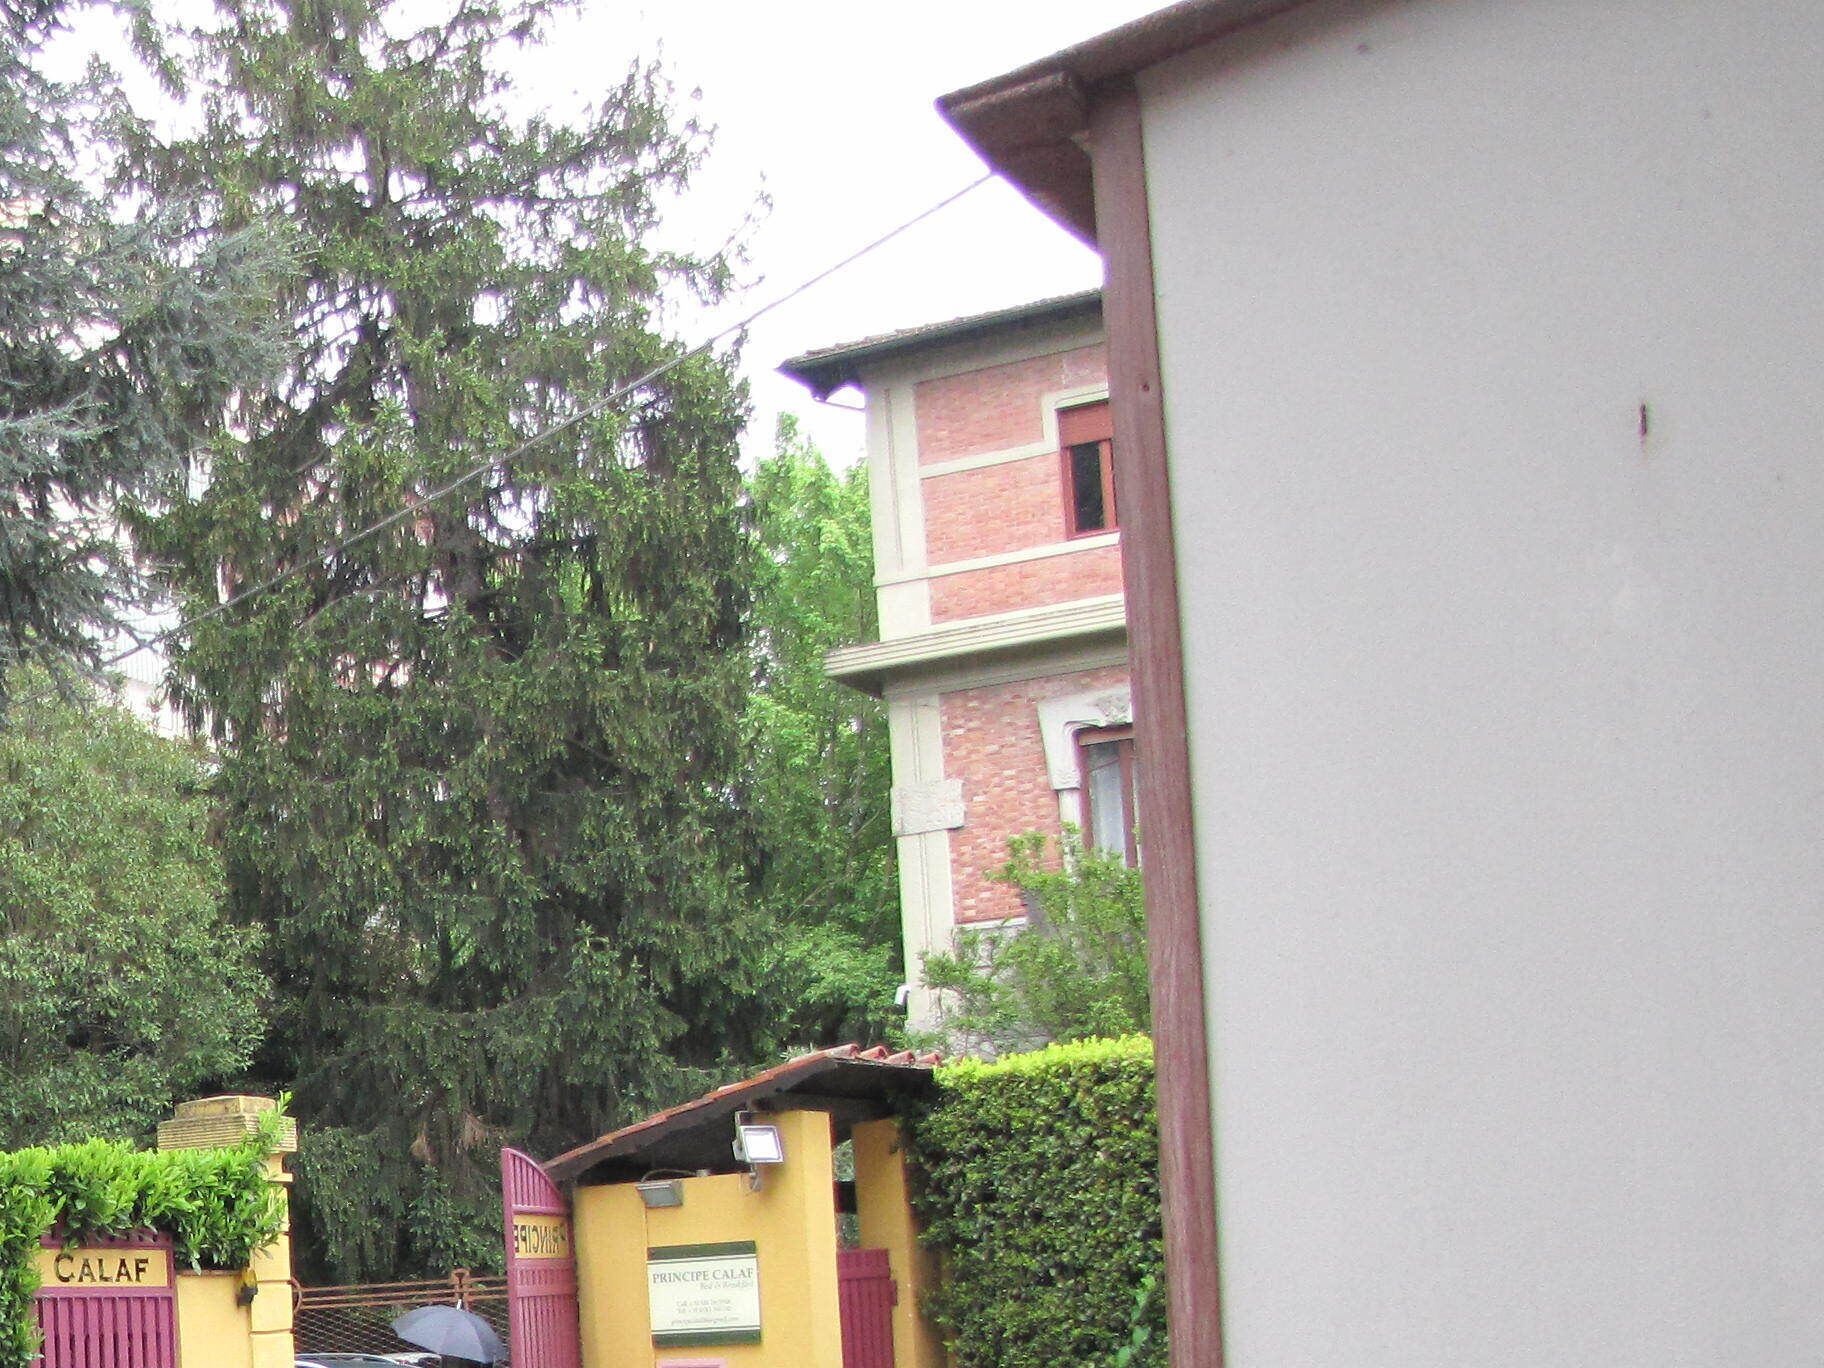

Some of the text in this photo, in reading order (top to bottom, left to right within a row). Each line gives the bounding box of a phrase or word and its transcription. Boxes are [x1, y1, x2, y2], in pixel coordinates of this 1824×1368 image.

[54, 1253, 149, 1283] CALAF
[652, 1267, 754, 1284] PRINCIPE CALAF
